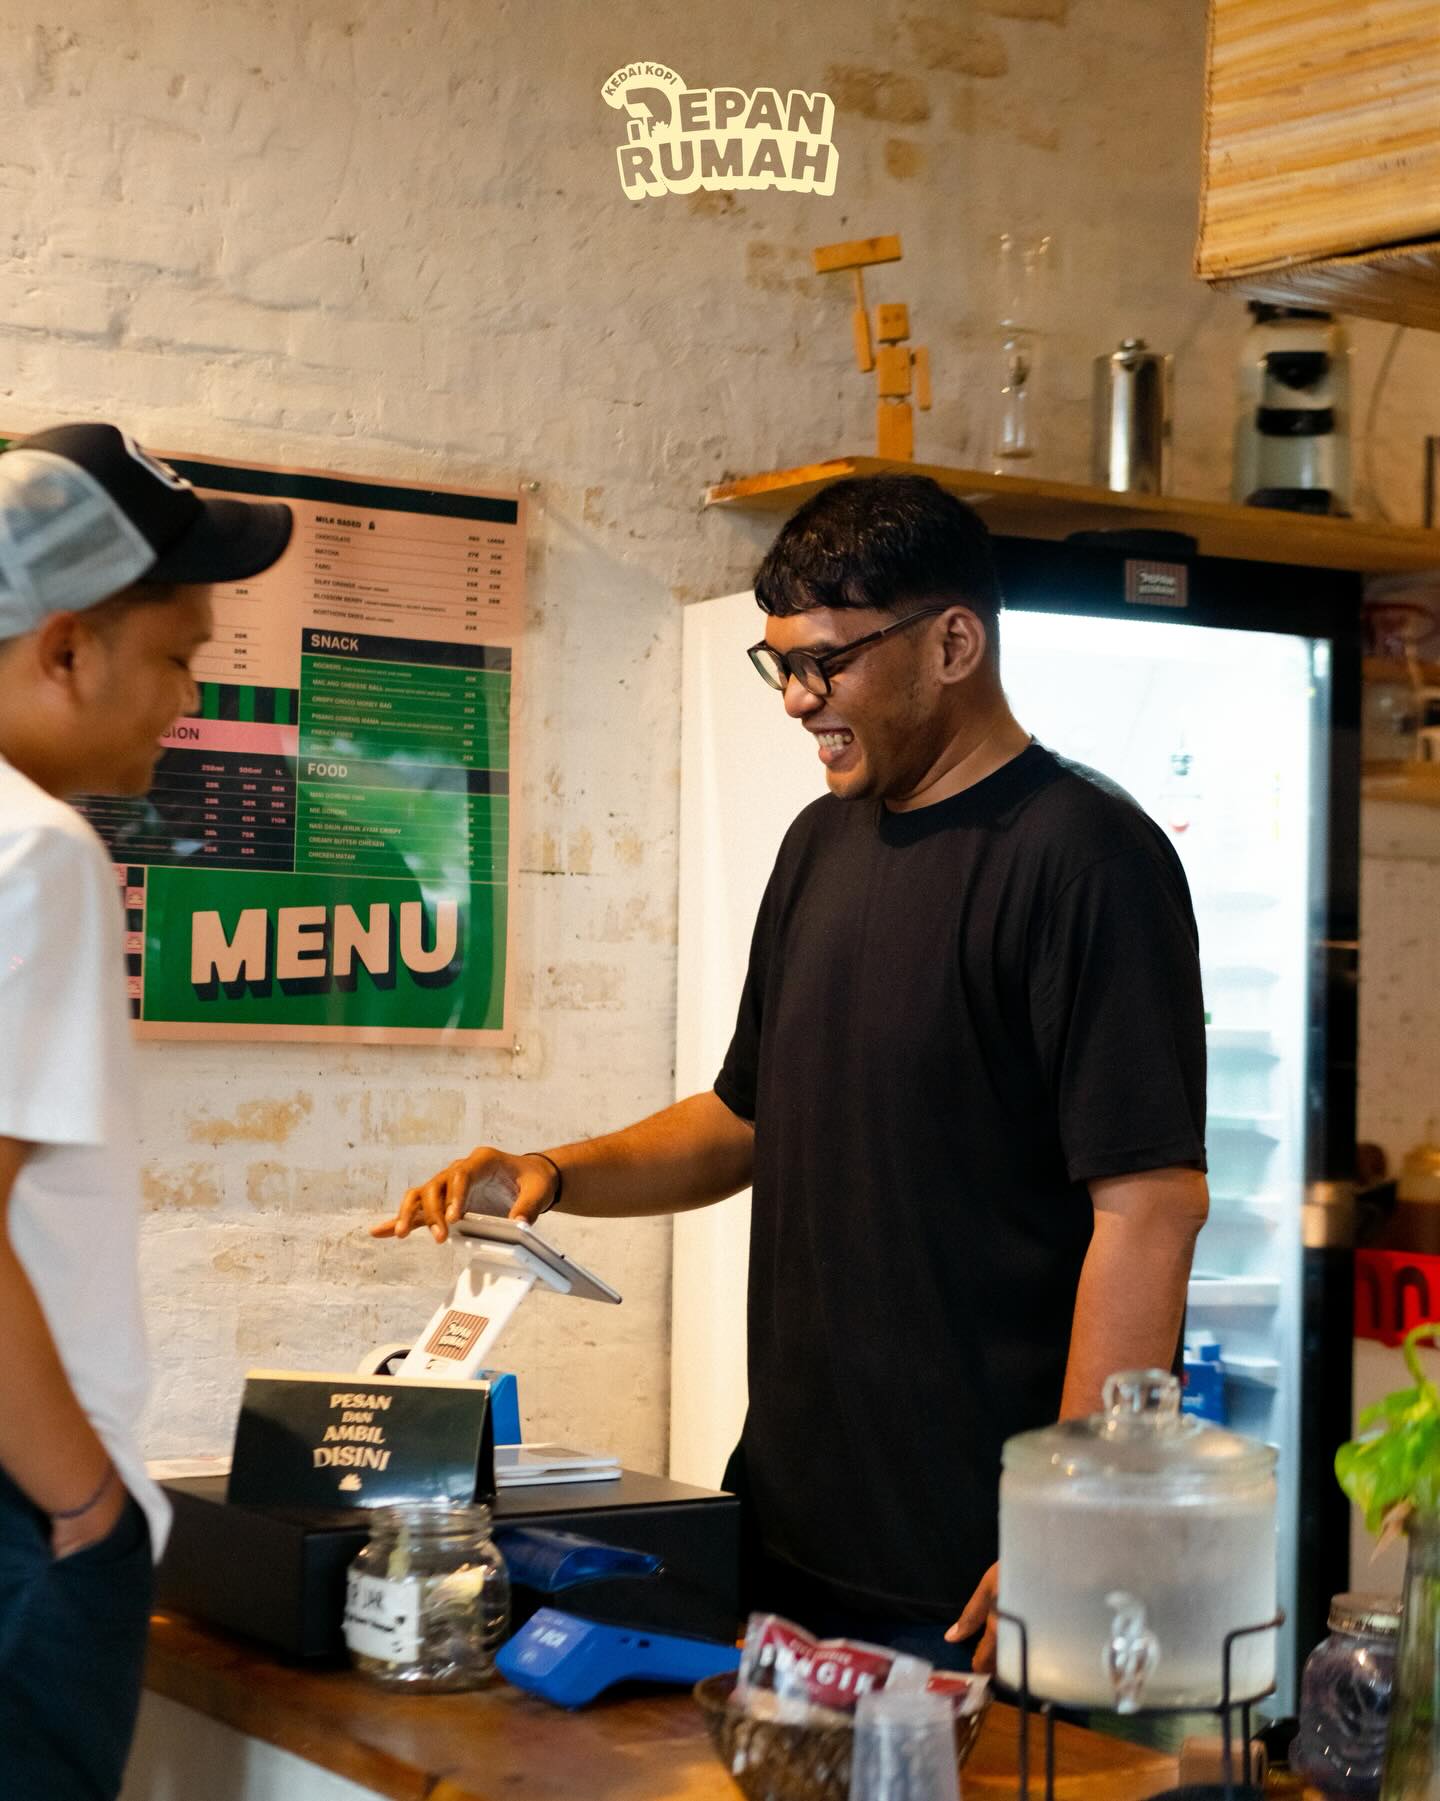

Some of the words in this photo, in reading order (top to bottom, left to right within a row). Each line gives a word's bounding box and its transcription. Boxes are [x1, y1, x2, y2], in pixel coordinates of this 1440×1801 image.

[311, 633, 359, 652] SNACK
[307, 761, 348, 778] FOOD
[191, 900, 460, 986] MENU
[330, 1393, 393, 1411] PESAN
[322, 1425, 387, 1445] AMBIL
[312, 1445, 392, 1472] DISINI
